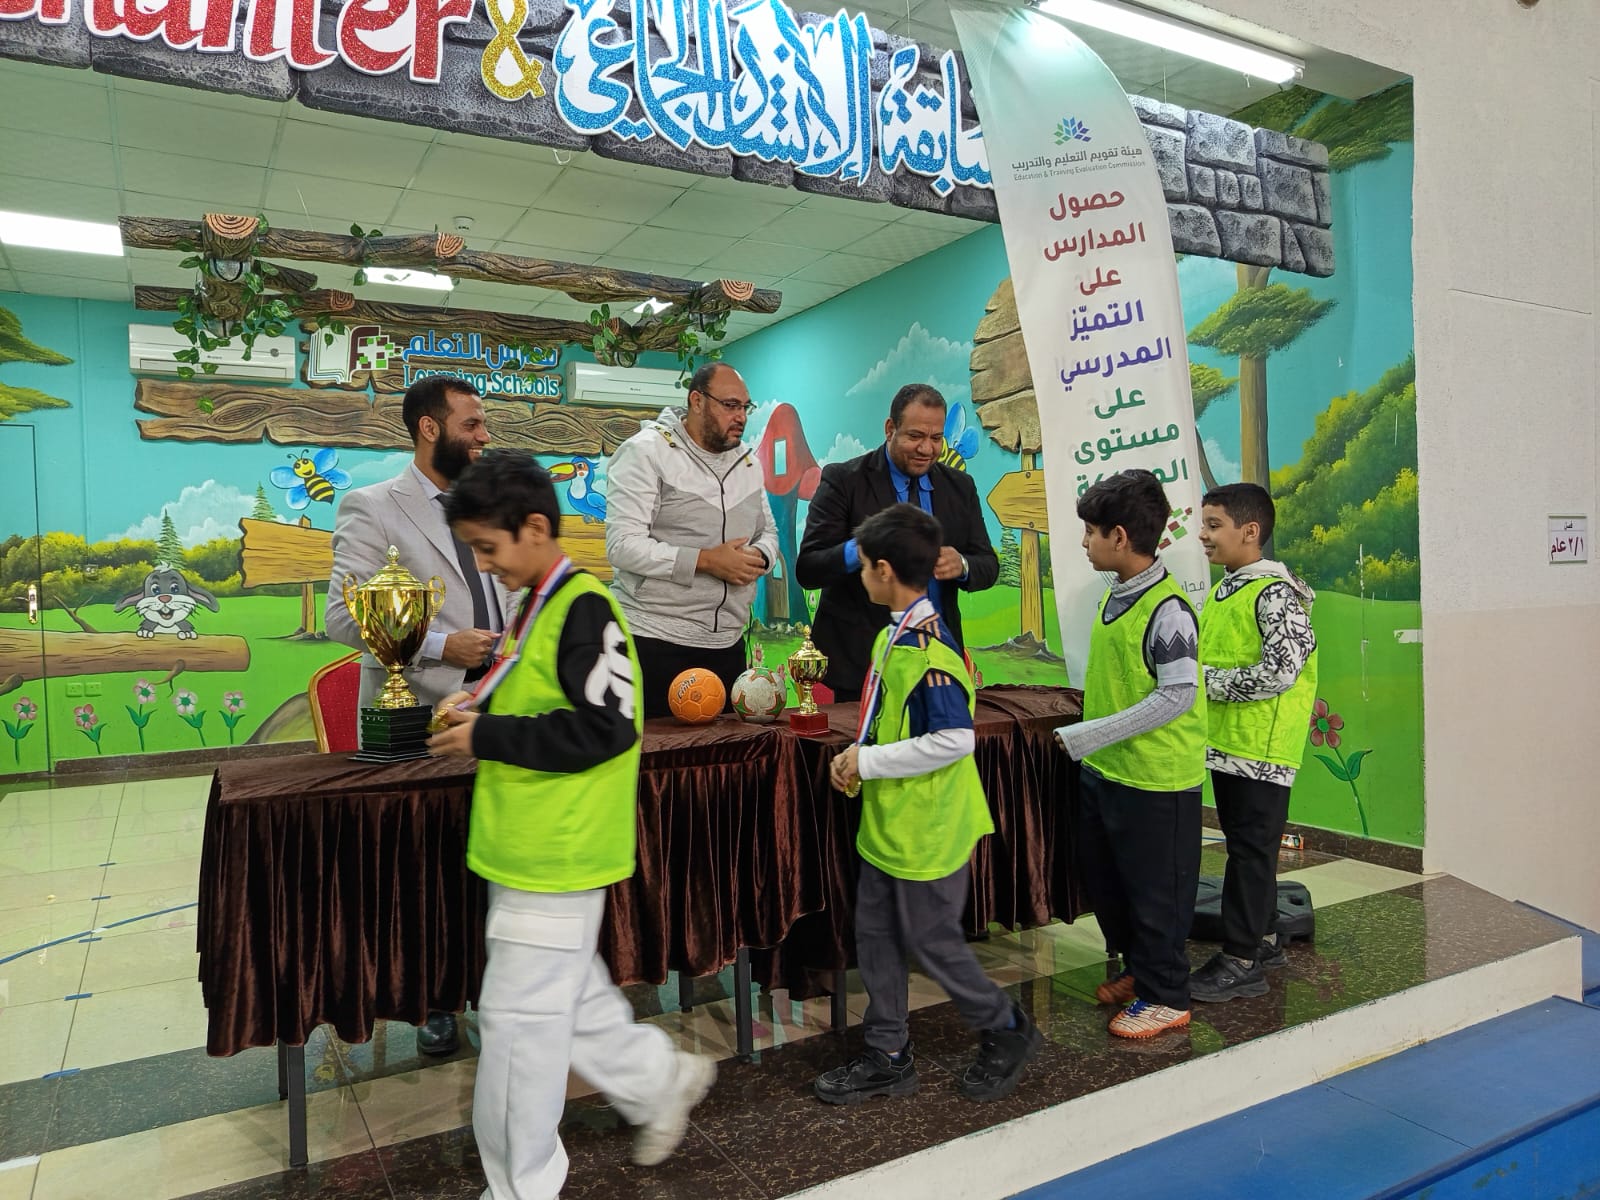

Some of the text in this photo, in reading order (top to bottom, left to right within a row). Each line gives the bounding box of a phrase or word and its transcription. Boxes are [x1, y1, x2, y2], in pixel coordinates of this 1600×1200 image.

[1011, 146, 1143, 172] هيئة تقويم التعليم والتدريب
[1014, 170, 1042, 181] Education
[1050, 167, 1075, 177] Training
[1108, 160, 1146, 169] Commission
[1049, 190, 1125, 221] حصول
[1043, 221, 1146, 261] المدارس
[1079, 266, 1122, 296] على
[402, 330, 482, 362] التعلم
[1060, 336, 1172, 392] المدرسي
[1094, 387, 1146, 419] على
[1074, 422, 1180, 465] مستوى
